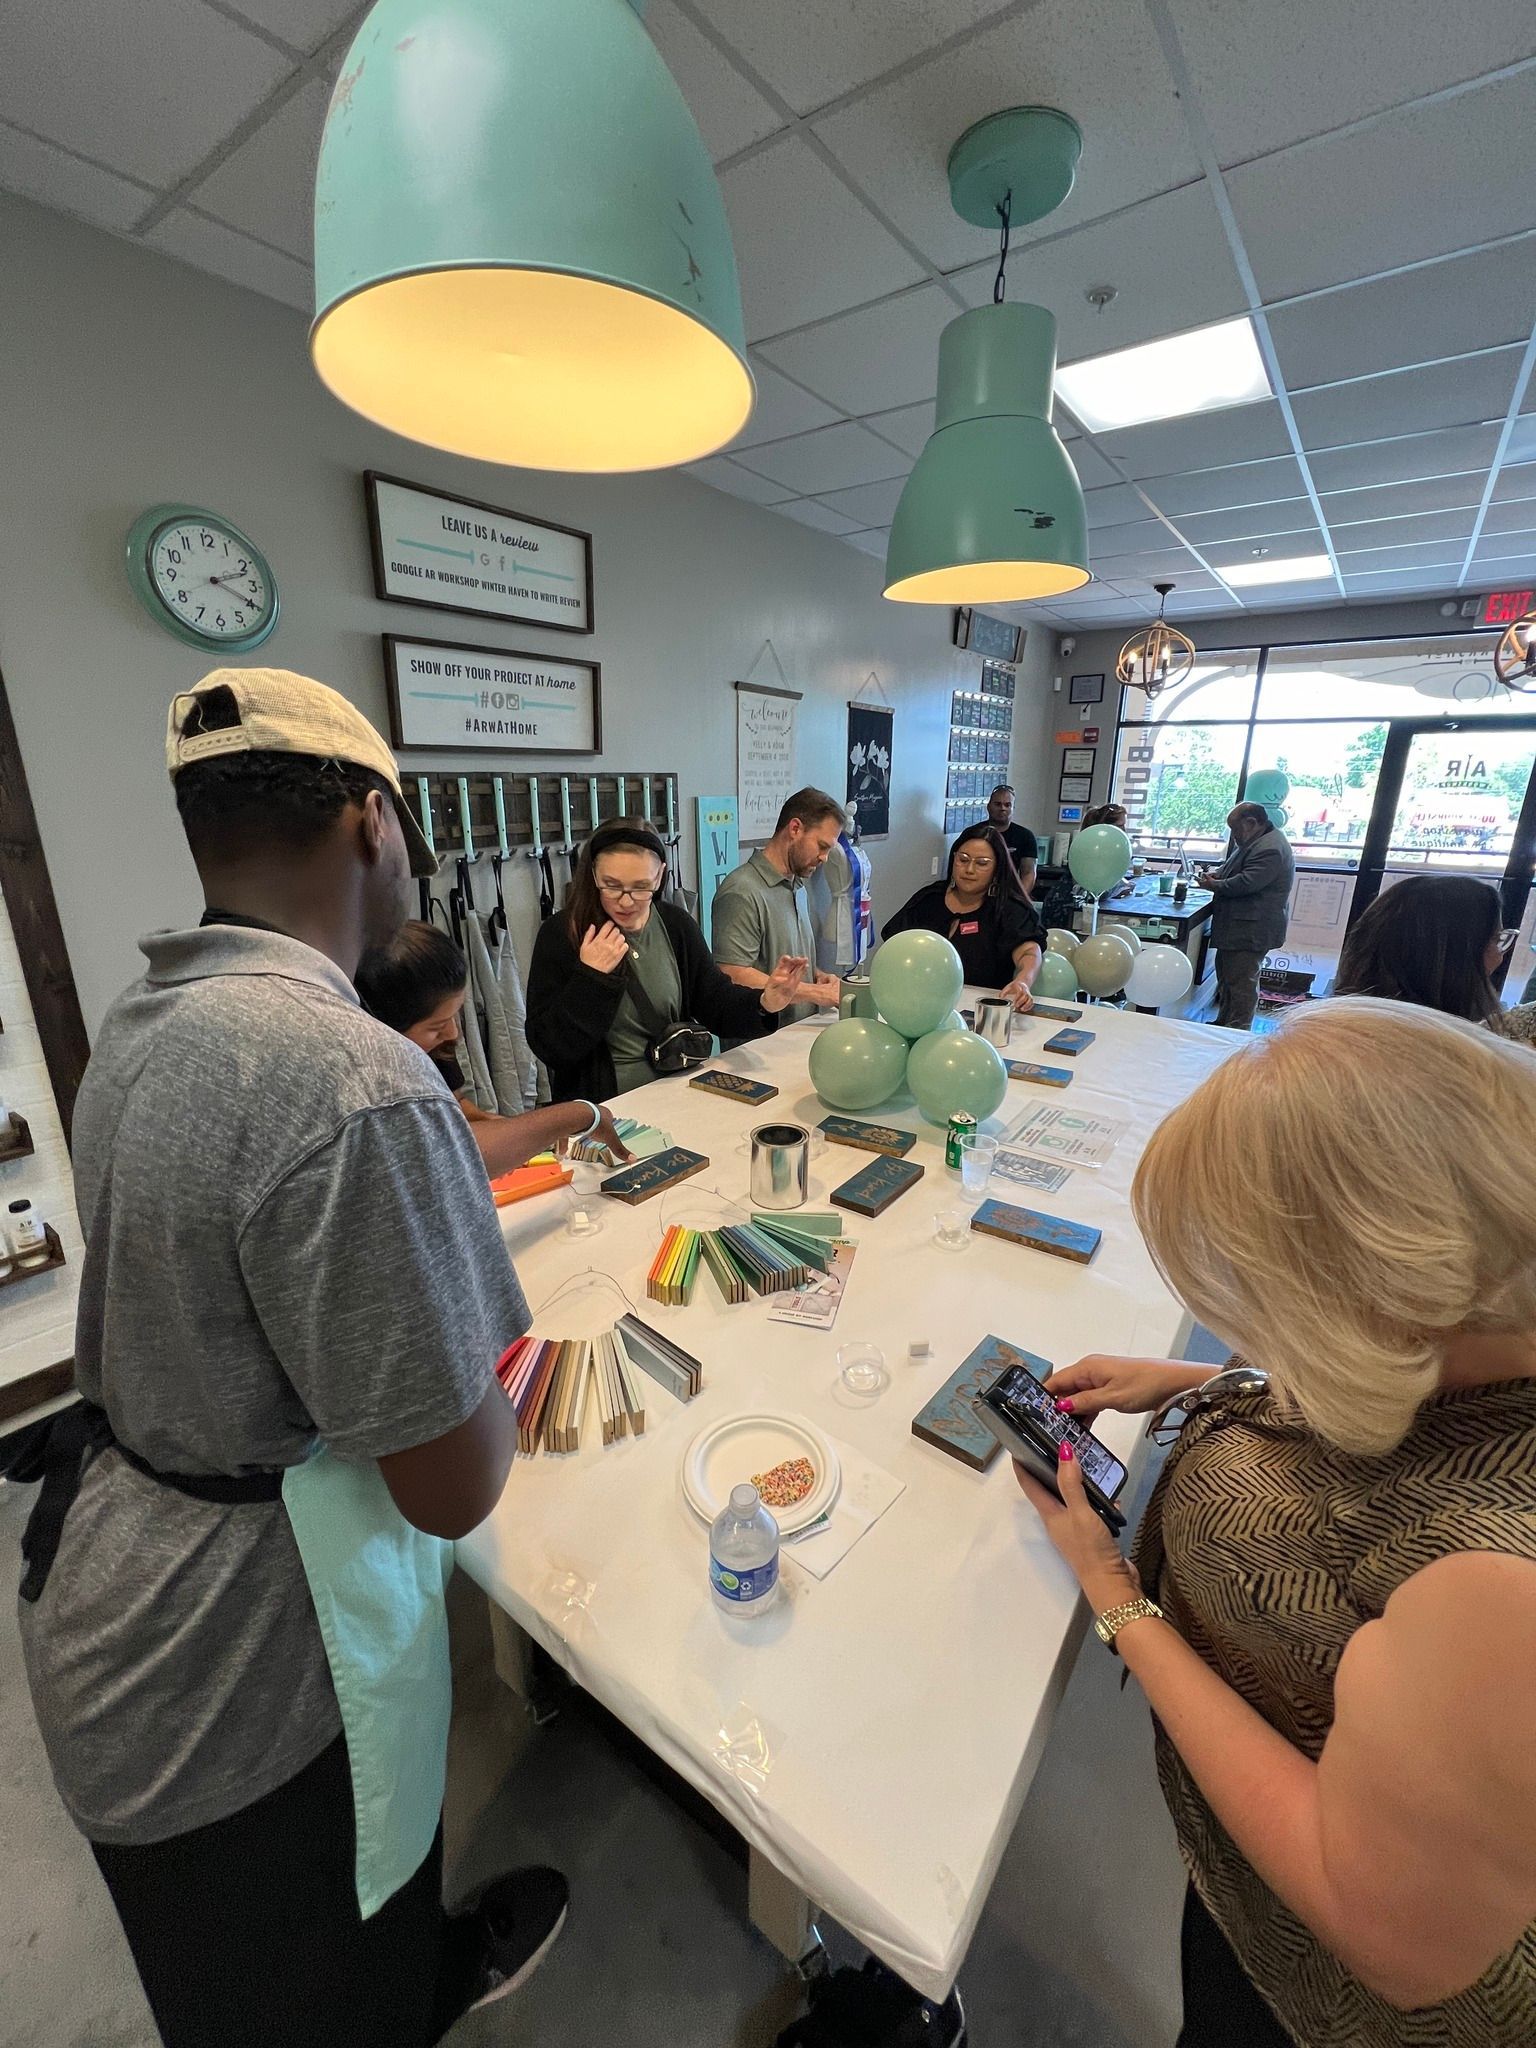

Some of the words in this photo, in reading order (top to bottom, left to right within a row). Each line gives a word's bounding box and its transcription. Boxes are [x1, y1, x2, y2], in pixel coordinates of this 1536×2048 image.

[442, 515, 472, 536] LEAVE
[474, 524, 488, 540] US
[491, 529, 497, 542] A
[499, 532, 540, 552] review
[181, 536, 191, 550] 11
[200, 533, 215, 549] 12
[168, 549, 181, 564] 10
[223, 543, 228, 556] 1
[238, 559, 248, 573] 2
[167, 568, 177, 582] 9
[248, 580, 258, 593] 3
[391, 562, 423, 578] GOOGLE
[425, 568, 436, 580] AR
[438, 571, 480, 588] WORKSHOP
[482, 581, 506, 594] WINTER
[508, 586, 529, 599] HAVEN
[530, 590, 539, 600] TO
[540, 592, 559, 605] WRITE
[560, 596, 581, 609] REVIEW
[178, 590, 188, 603] 8
[196, 607, 205, 620] 7
[1485, 591, 1533, 624] EXIT
[216, 614, 226, 627] 6
[235, 611, 244, 624] 5
[410, 659, 441, 676] SHOW
[445, 664, 462, 678] OFF
[465, 666, 491, 681] YOUR
[494, 669, 532, 686] PROJECT
[535, 674, 545, 686] AT
[546, 675, 576, 691] home
[748, 752, 772, 760] SEPTEMBER
